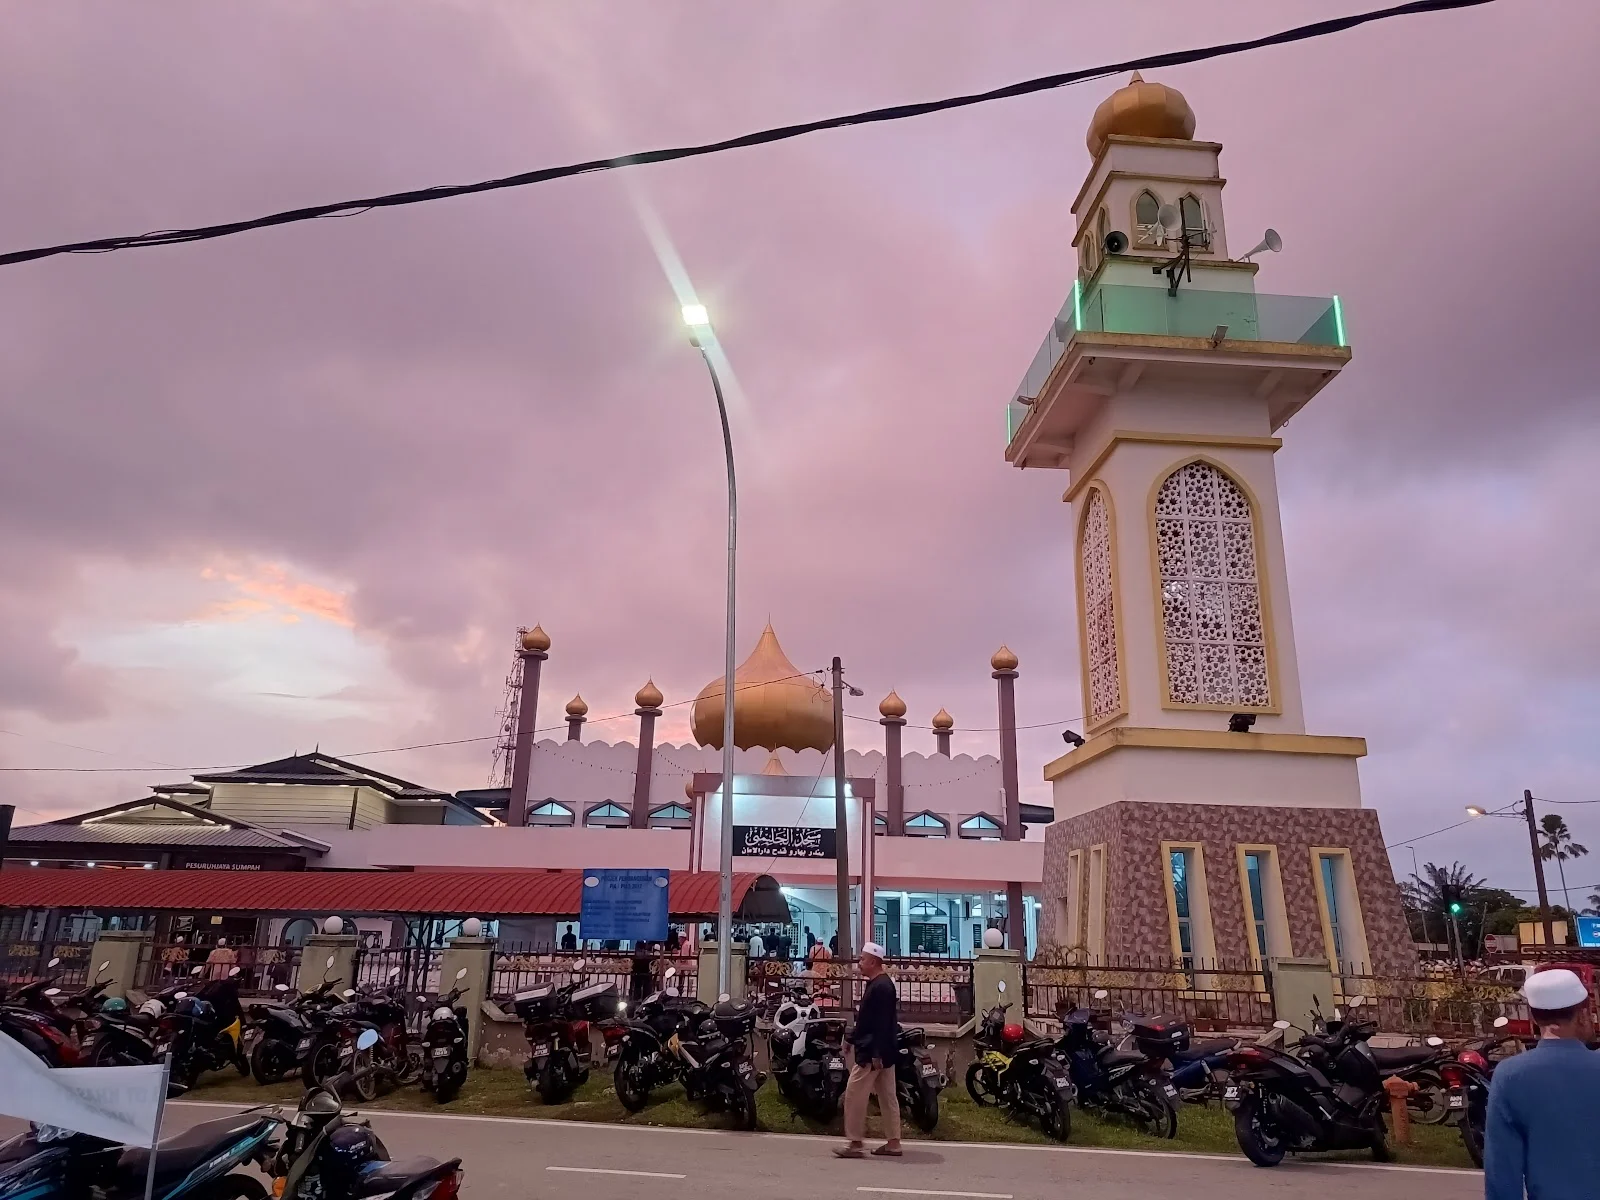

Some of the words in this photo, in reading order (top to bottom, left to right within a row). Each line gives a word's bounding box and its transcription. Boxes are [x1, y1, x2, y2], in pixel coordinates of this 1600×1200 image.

[794, 828, 822, 848] مسجد
[771, 847, 788, 856] قدح
[788, 848, 807, 857] بهارو
[185, 862, 231, 870] PESURUHJAYA
[231, 863, 261, 871] SUMPAH
